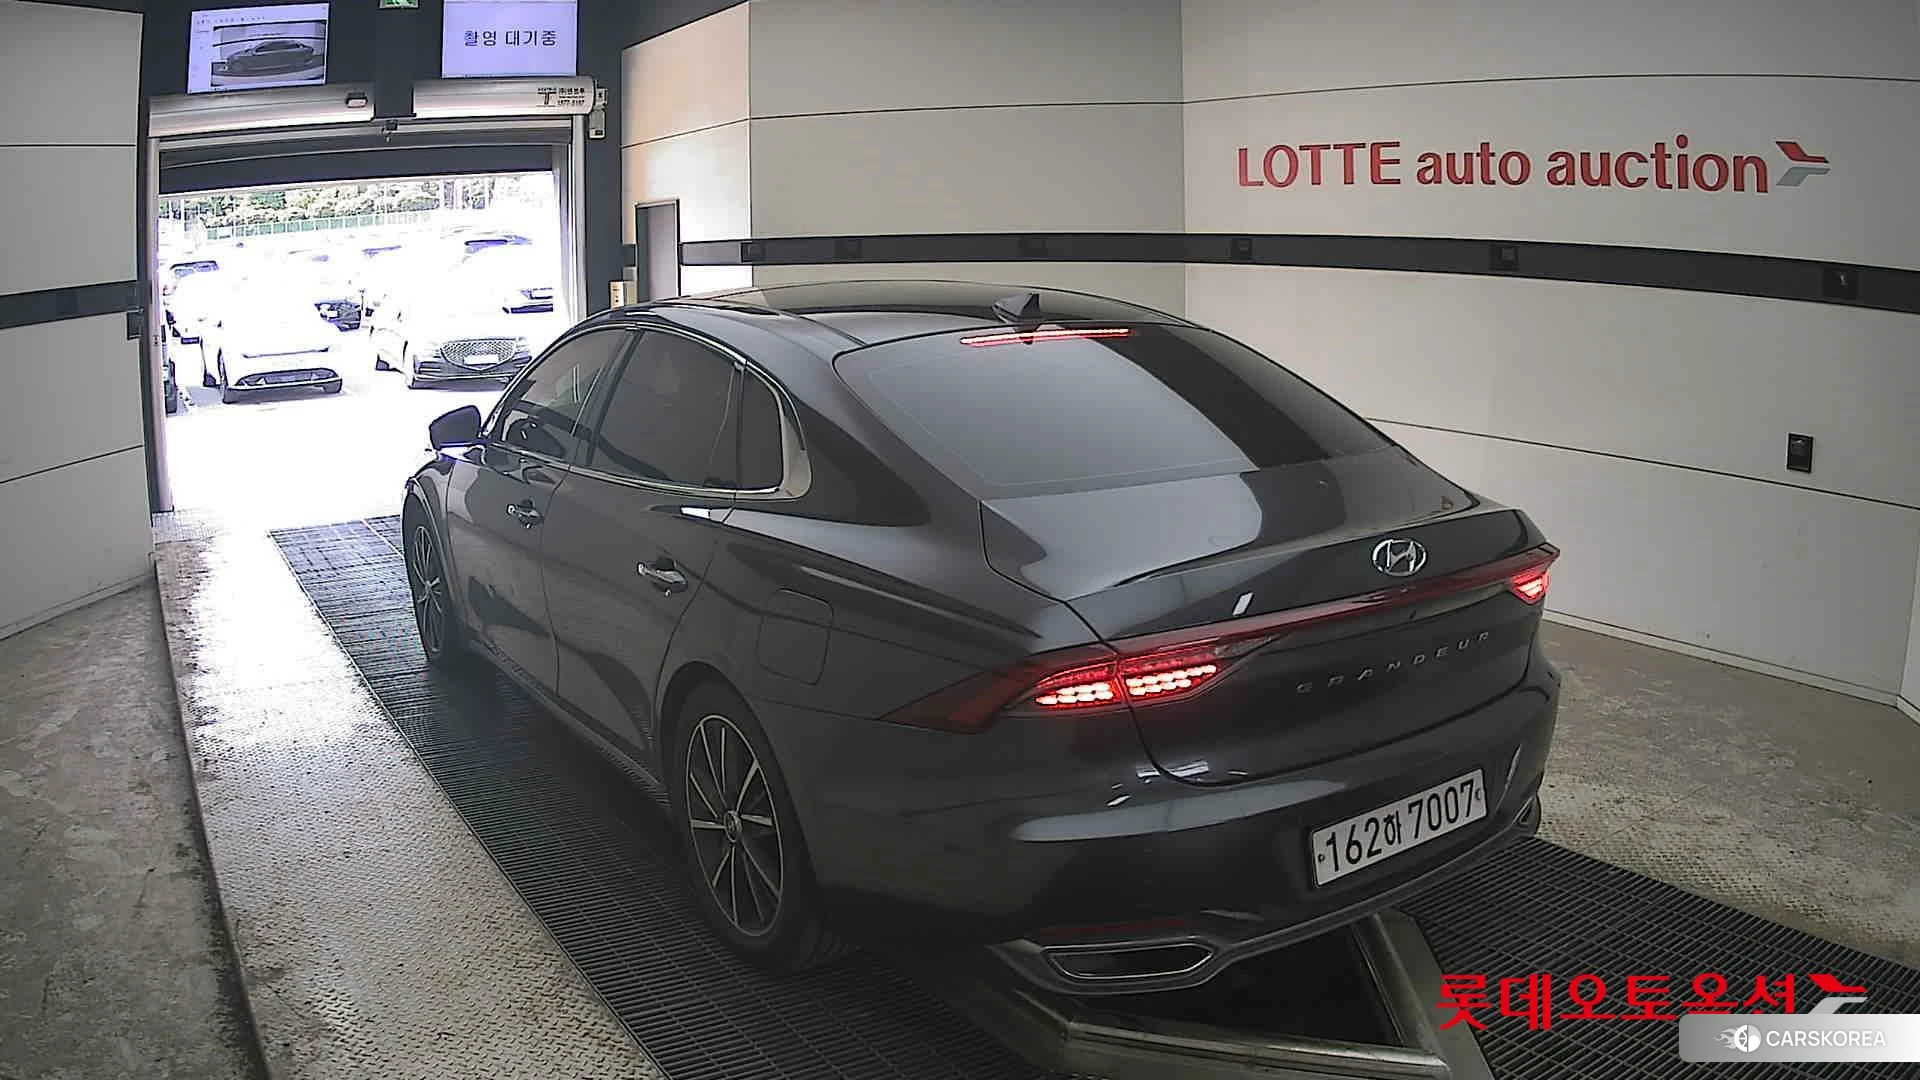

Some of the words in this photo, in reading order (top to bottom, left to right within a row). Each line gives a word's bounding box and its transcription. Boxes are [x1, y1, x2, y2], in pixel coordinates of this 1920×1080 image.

[464, 30, 497, 47] 촬영
[504, 30, 556, 47] 대기중
[1238, 141, 1401, 188] LOTTE
[1416, 142, 1531, 186] auto
[1546, 134, 1769, 193] auction
[1296, 631, 1489, 693] GRANDEUR
[1326, 811, 1402, 872] 162하
[1408, 779, 1474, 839] 7007
